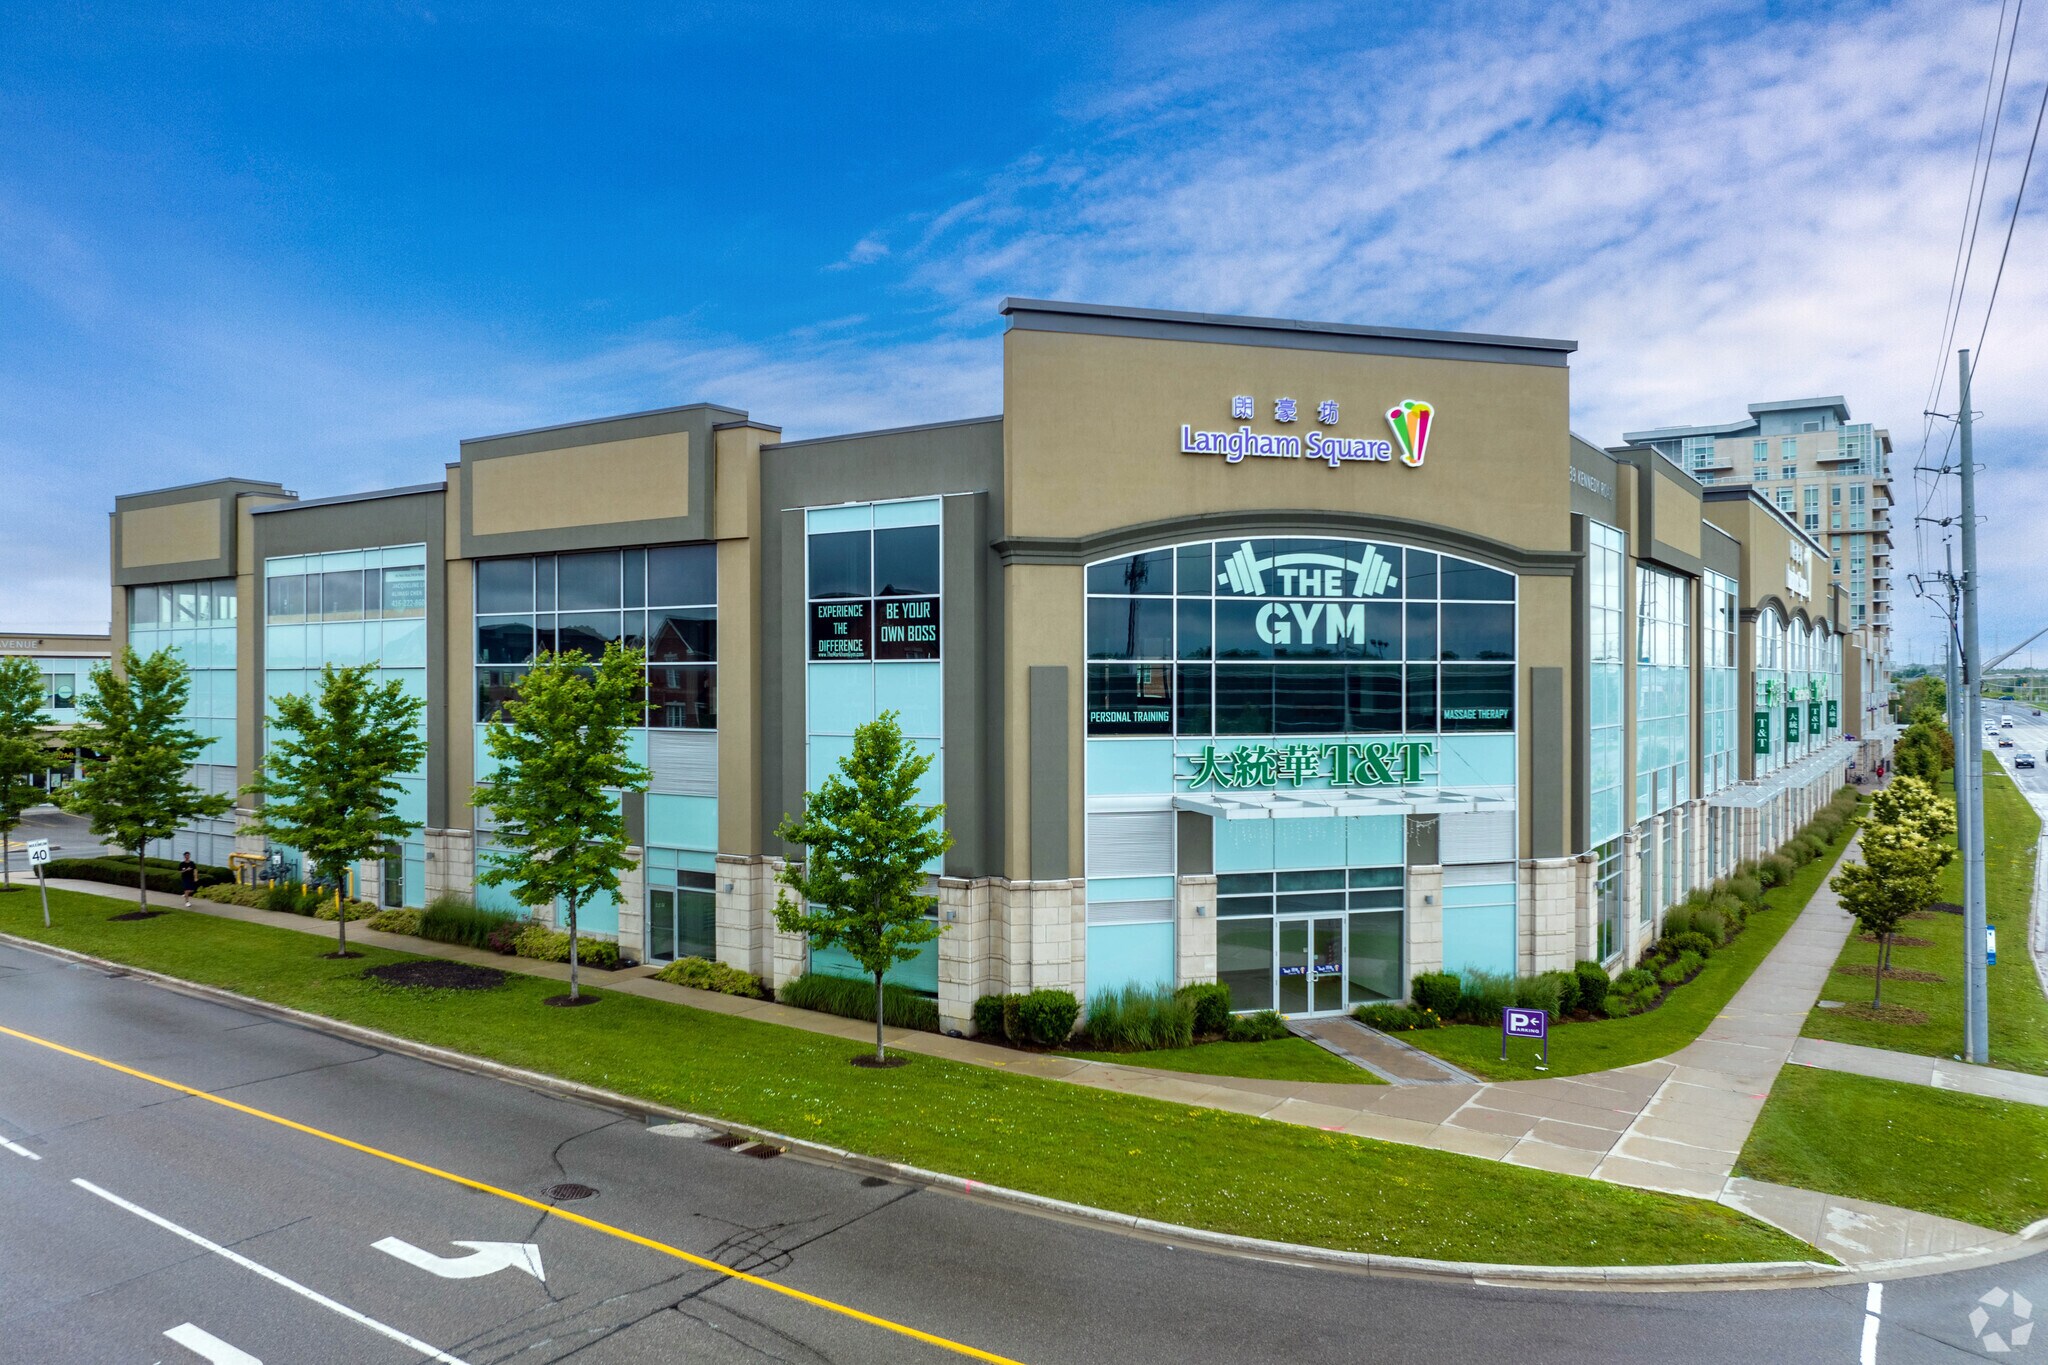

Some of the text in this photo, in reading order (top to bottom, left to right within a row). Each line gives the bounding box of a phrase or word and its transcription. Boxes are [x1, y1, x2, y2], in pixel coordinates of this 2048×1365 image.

[1232, 395, 1339, 425] 朗豪坊
[1181, 424, 1392, 467] Langham Square
[1277, 568, 1343, 597] THE
[818, 604, 863, 618] EXPERIENCE
[886, 601, 931, 619] BE YOUR
[833, 622, 848, 635] THE
[1254, 602, 1366, 646] GYM
[881, 625, 936, 642] OWN BOSS
[0, 640, 38, 649] VENUE
[818, 639, 863, 652] DIFFERENCE
[1090, 711, 1169, 722] PERSONAL TRAINING
[1444, 709, 1509, 719] MASSAGE THERAPY
[1811, 707, 1820, 730] T&T
[1757, 718, 1768, 748] T&T
[1189, 741, 1433, 788] 大統華 T&T
[32, 849, 47, 861] 40
